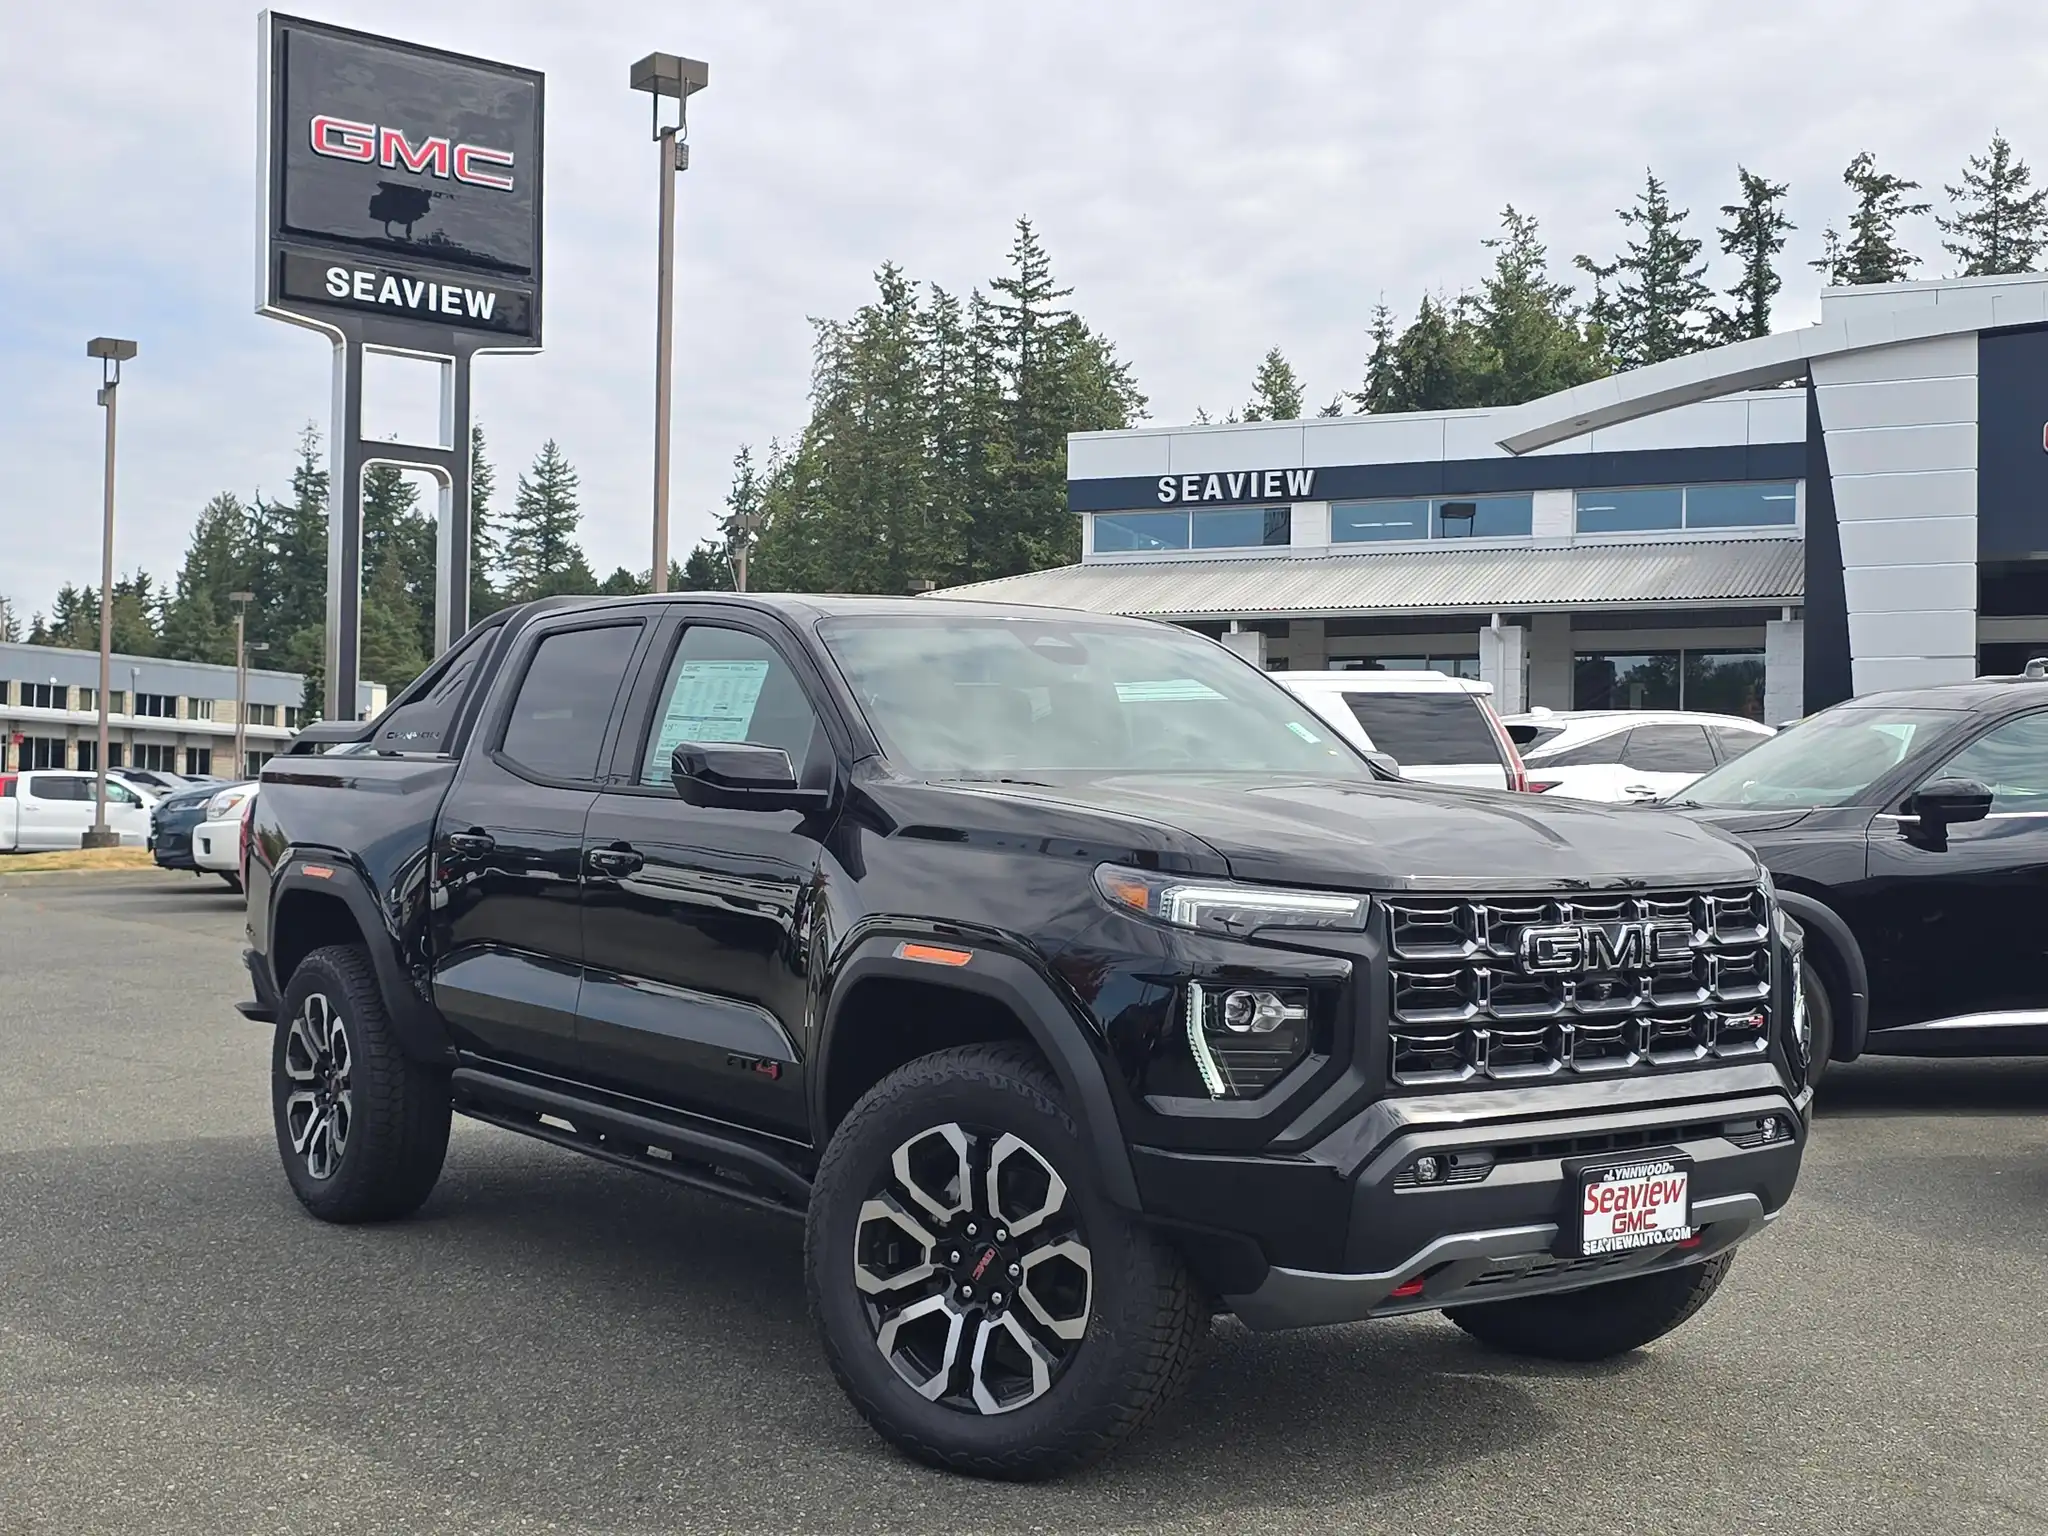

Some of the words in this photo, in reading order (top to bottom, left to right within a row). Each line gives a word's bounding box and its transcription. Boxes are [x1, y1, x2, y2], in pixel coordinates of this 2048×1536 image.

[311, 114, 514, 191] GMC
[325, 267, 496, 320] SEAVIEW
[1157, 469, 1316, 503] SEAVIEW
[1521, 921, 1694, 974] GMC
[1608, 1162, 1670, 1181] LYNNWOOD
[1584, 1177, 1685, 1215] Seaview
[1612, 1208, 1658, 1235] GMC
[1583, 1226, 1691, 1256] SEAVIEWAUTO.COM
